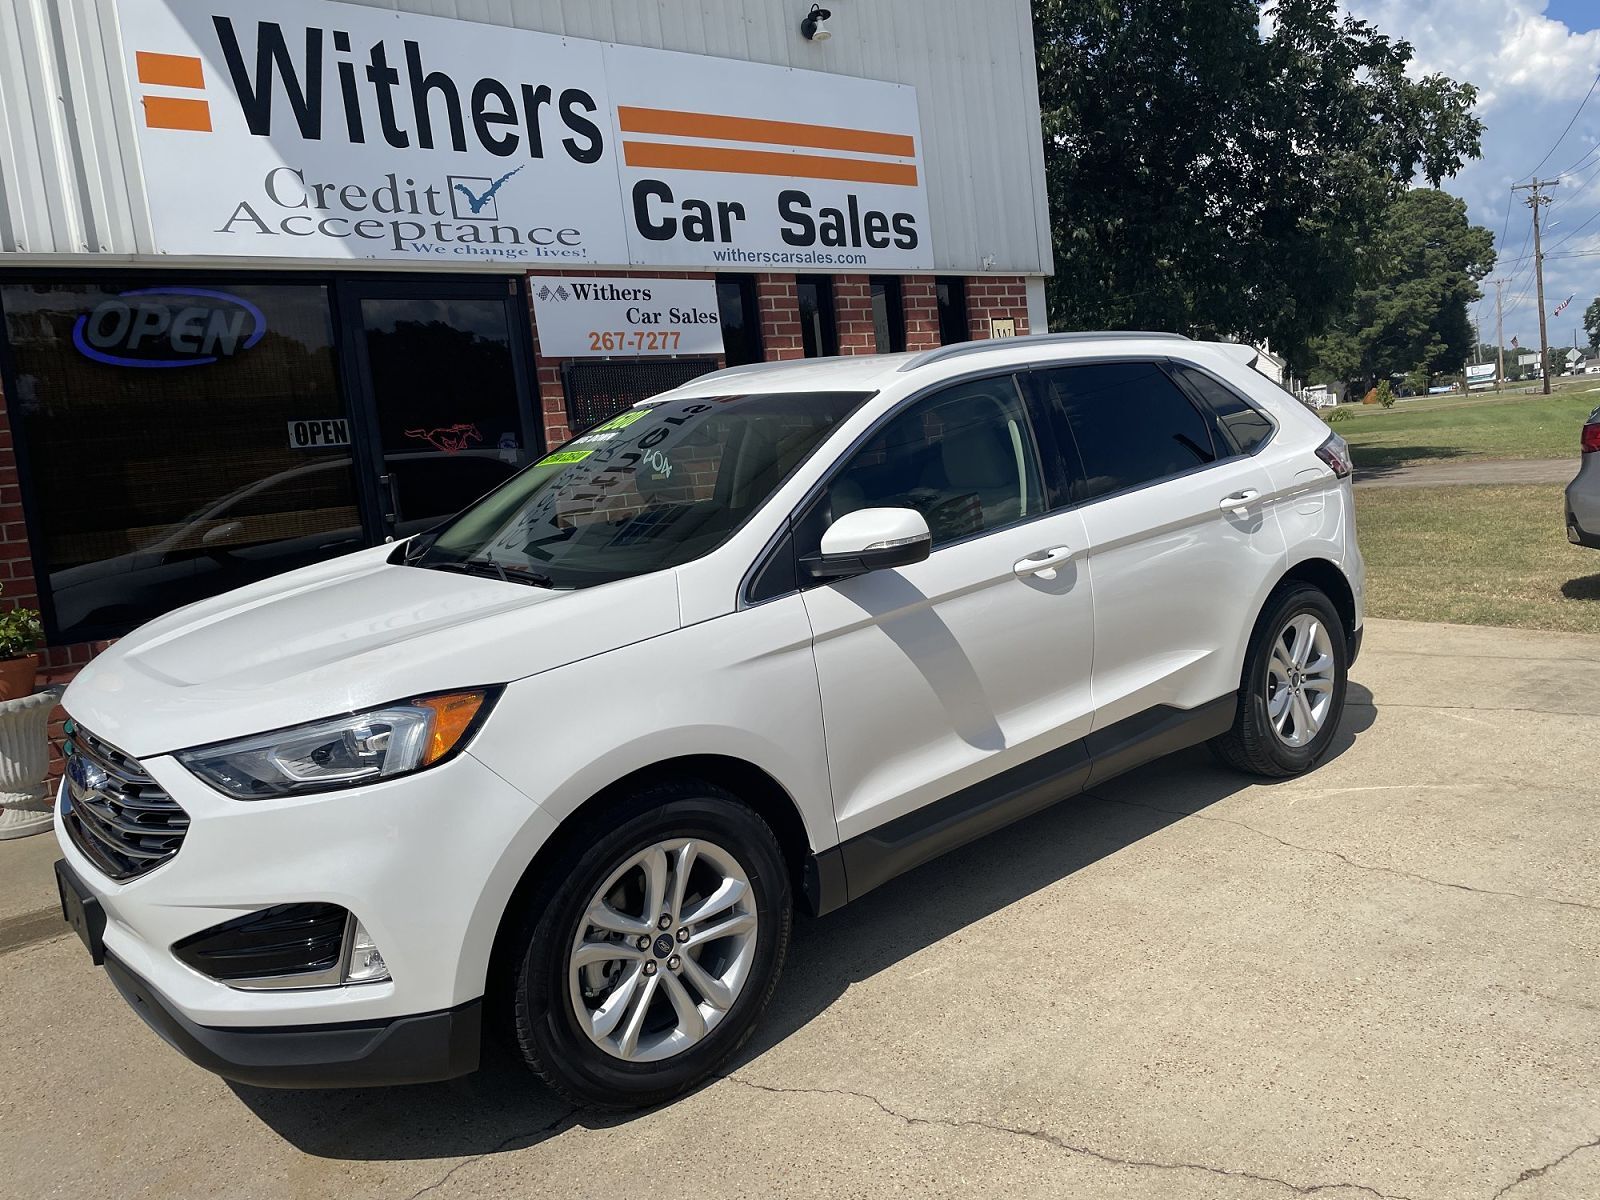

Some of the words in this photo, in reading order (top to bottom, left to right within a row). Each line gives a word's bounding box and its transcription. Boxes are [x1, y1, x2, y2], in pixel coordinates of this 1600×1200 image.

[211, 15, 604, 164] Withers
[264, 166, 446, 217] Credit
[214, 200, 582, 252] Acceptance
[632, 179, 746, 243] Car
[777, 189, 919, 250] Sales
[411, 242, 446, 256] We
[453, 244, 529, 259] change
[534, 245, 587, 258] lives!
[713, 248, 867, 265] witherscarsales.com
[571, 283, 652, 301] Withers
[87, 300, 247, 356] OPEN
[626, 307, 662, 324] Car
[669, 307, 719, 324] Sales
[588, 331, 681, 351] 267-7277
[294, 420, 348, 447] OPEN
